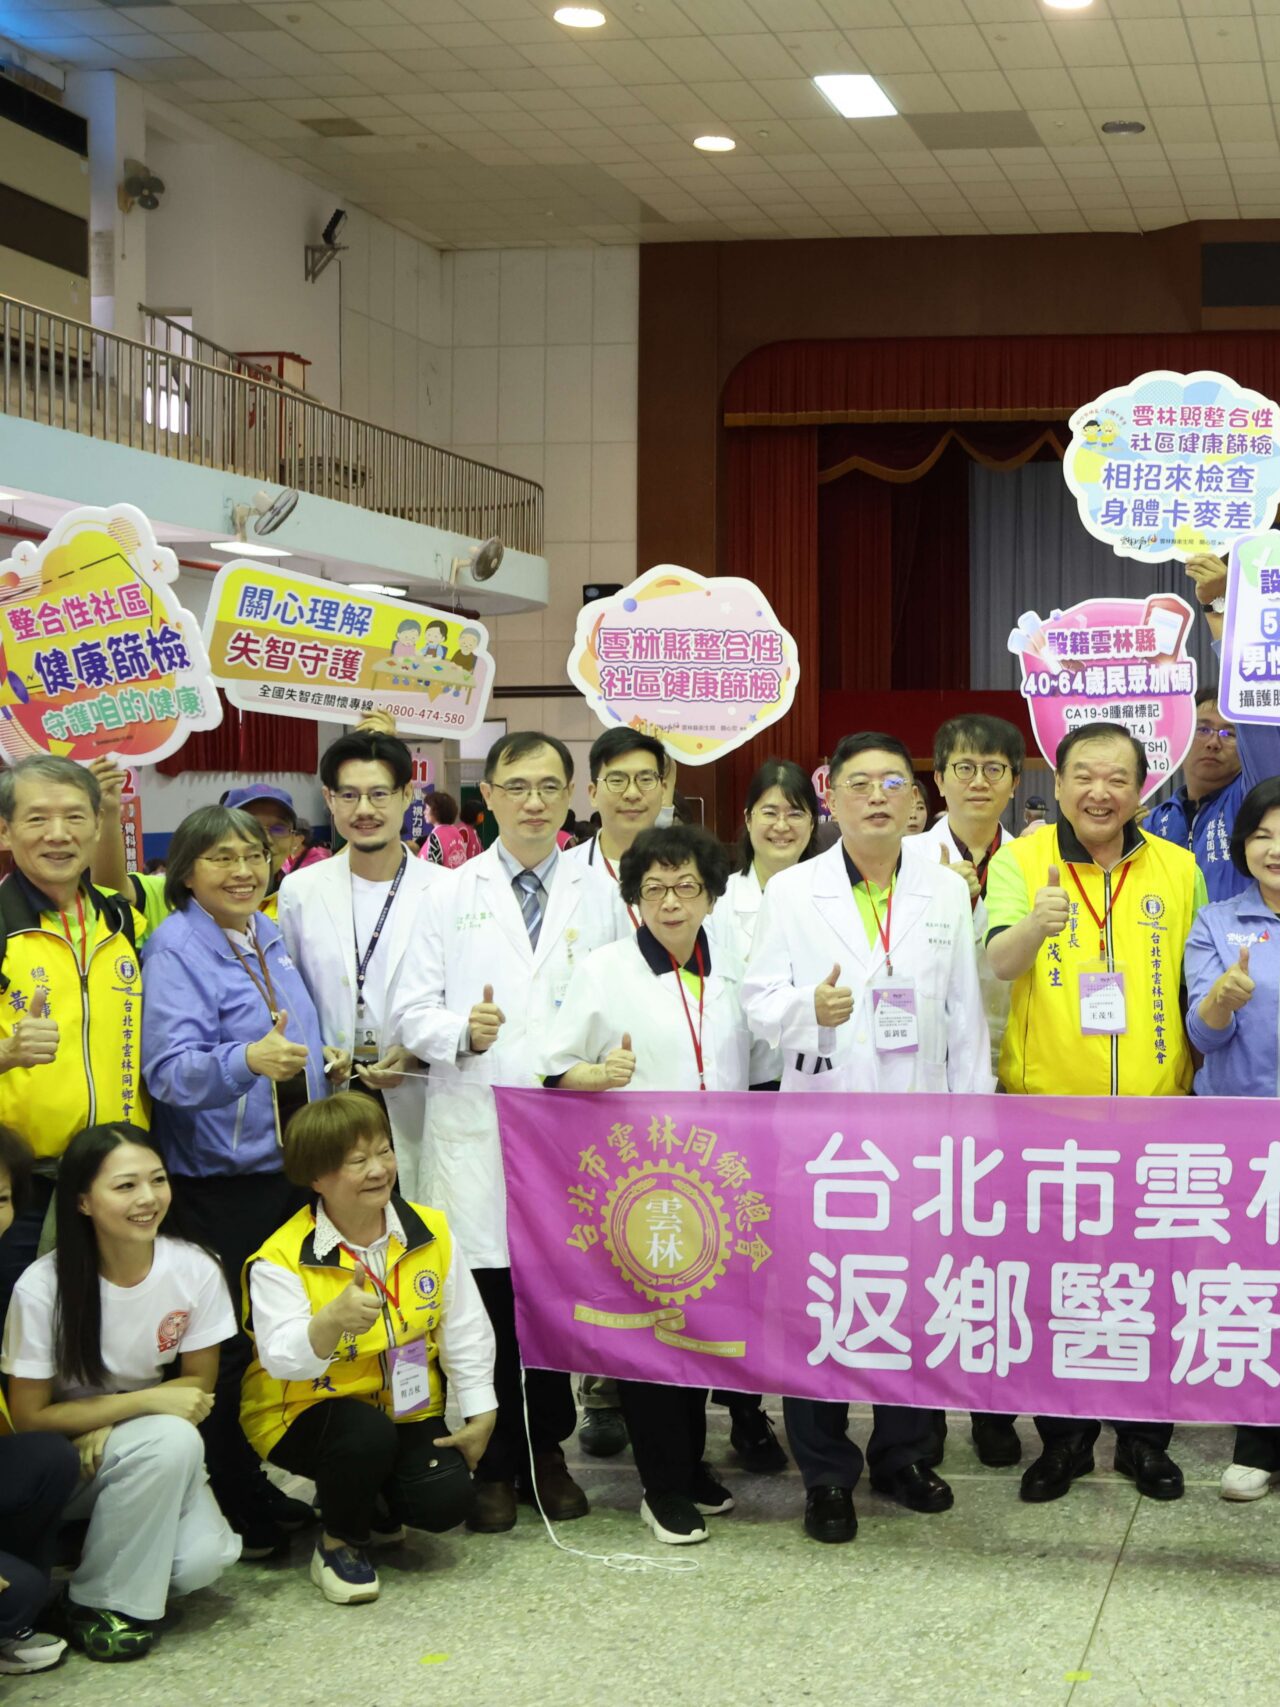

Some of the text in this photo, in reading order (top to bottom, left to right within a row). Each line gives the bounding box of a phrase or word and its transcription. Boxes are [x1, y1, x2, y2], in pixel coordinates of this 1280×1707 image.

[1132, 405, 1274, 428] 雲林縣整合性
[1130, 432, 1272, 455] 社區健康篩檢
[1102, 463, 1255, 493] 相招來檢查
[1101, 498, 1252, 528] 身體卡麥差
[7, 582, 152, 642] 整合性社區
[237, 585, 372, 639] 關心理解
[33, 625, 191, 696] 健康篩檢
[226, 631, 365, 683] 失智守護
[600, 629, 783, 663] 雲林縣整合性
[1048, 628, 1156, 655] 設籍雲林縣
[602, 667, 781, 701] 社區健康篩檢
[1025, 664, 1191, 695] 40~64歲民眾加碼
[41, 686, 205, 742] 守護咱的健康
[386, 703, 465, 726] 0800-474-580
[1066, 704, 1160, 719] CA19-9腫瘤標記
[1047, 932, 1063, 987] 茂生
[1150, 932, 1167, 1065] 台北市雲林同鄉會總會
[121, 999, 135, 1124] 台北市雲林同鄉會
[566, 1115, 773, 1272] 台北市雲林同鄉總會
[645, 1196, 684, 1269] 雲林
